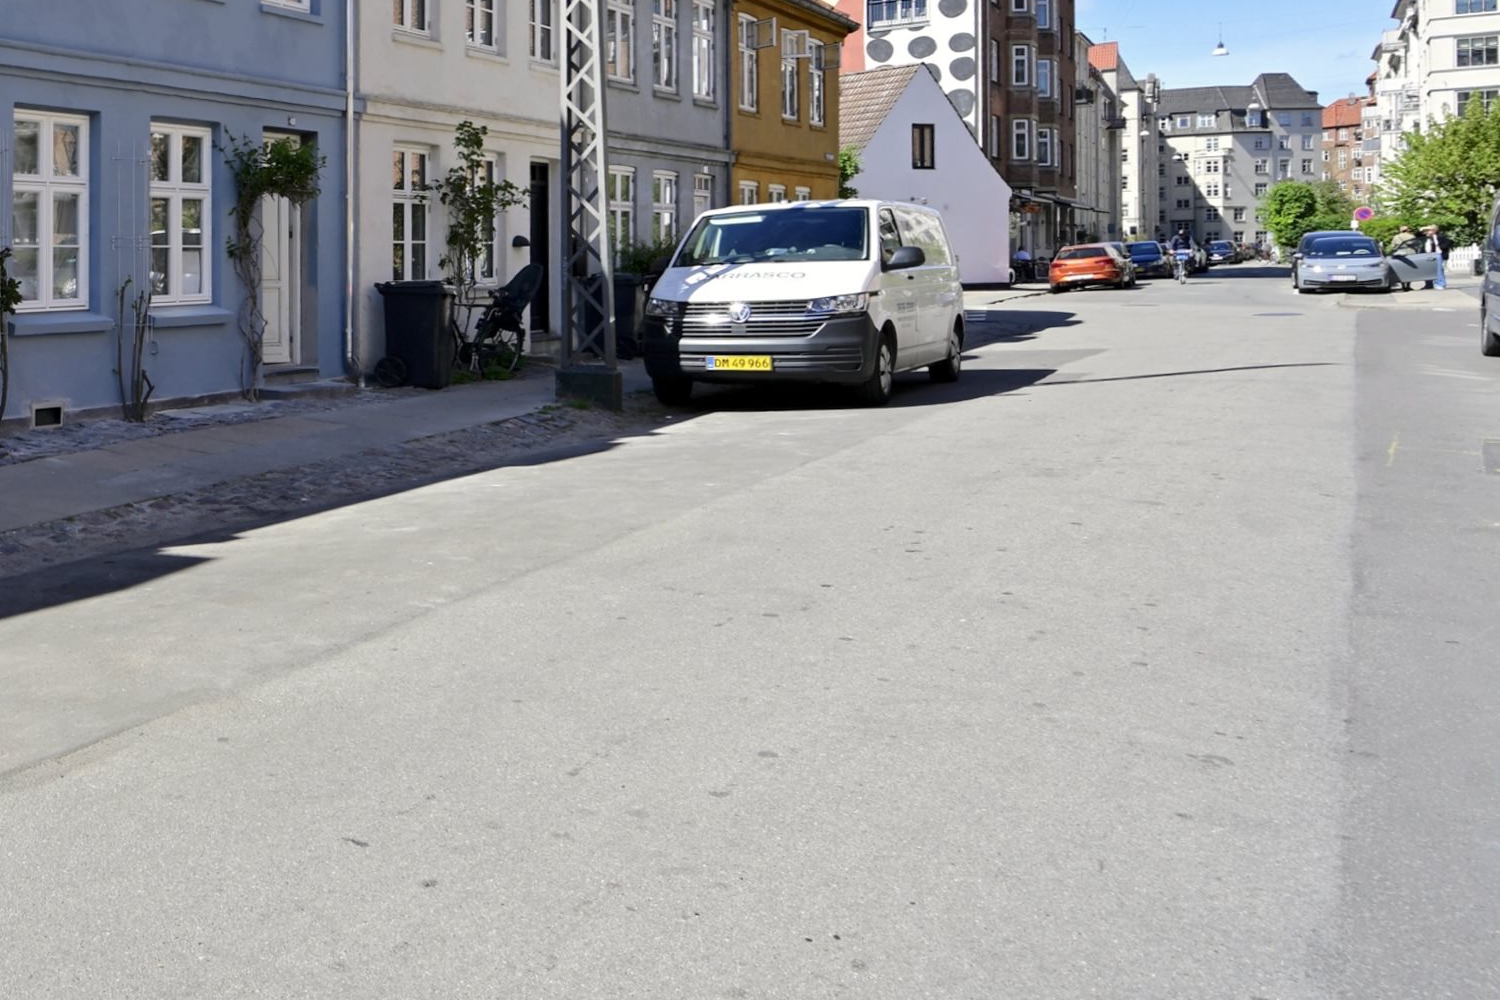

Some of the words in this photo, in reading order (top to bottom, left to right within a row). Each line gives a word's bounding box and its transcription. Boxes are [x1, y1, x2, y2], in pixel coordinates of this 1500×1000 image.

[696, 271, 807, 281] ARRASCO
[731, 358, 746, 368] 49
[747, 358, 769, 368] 966
